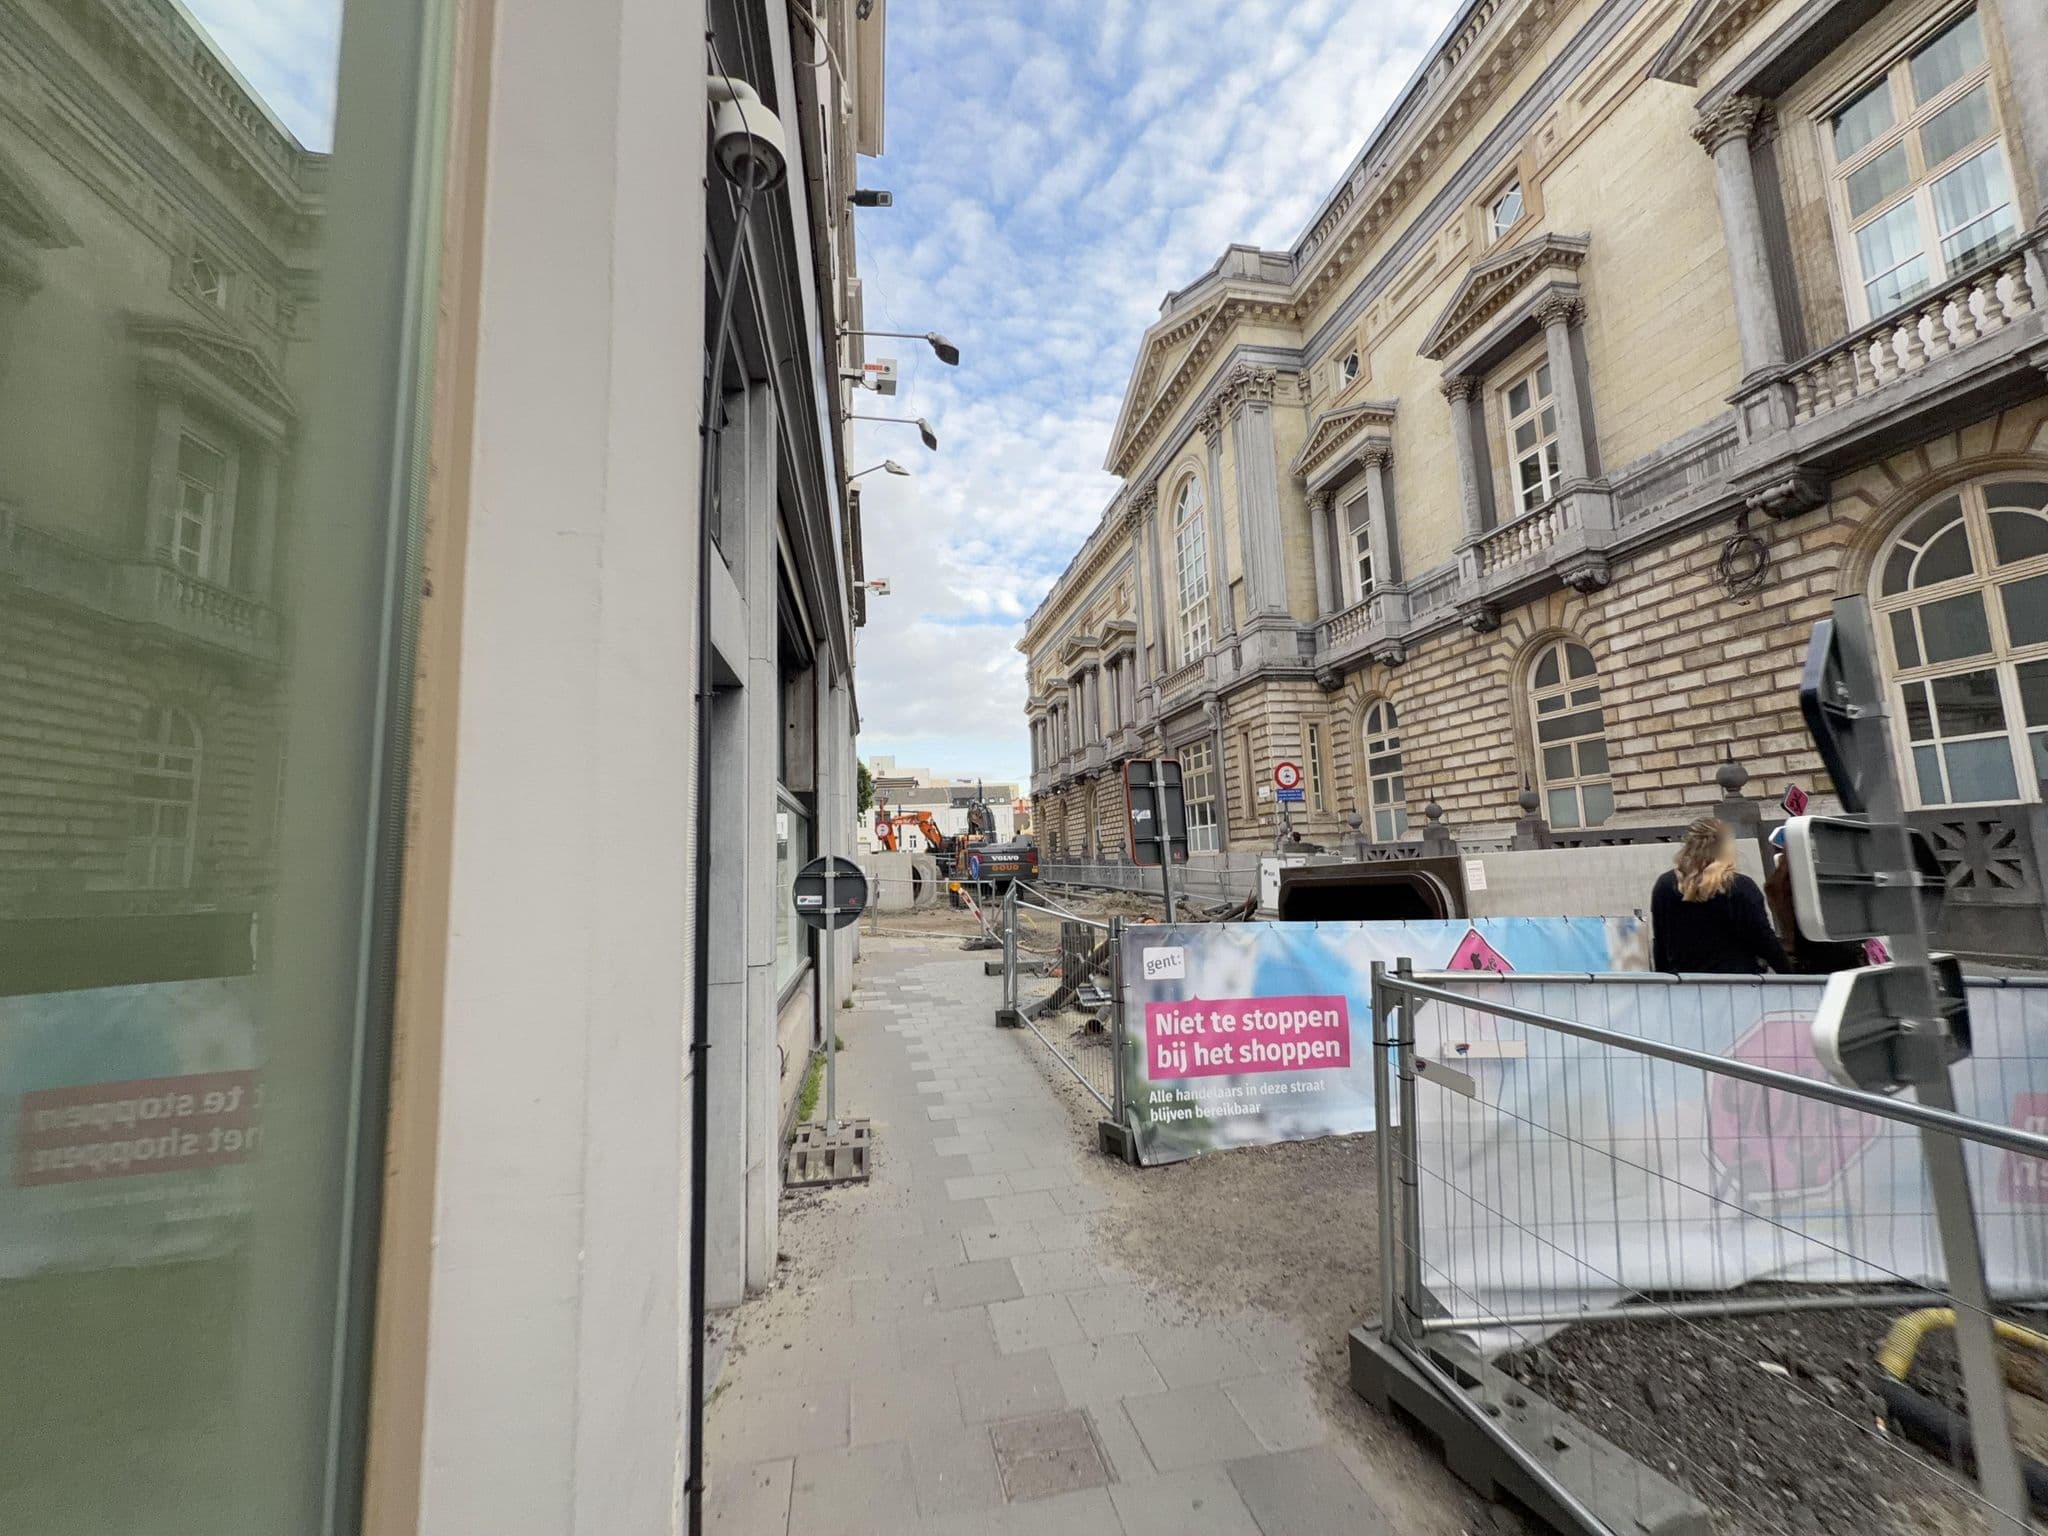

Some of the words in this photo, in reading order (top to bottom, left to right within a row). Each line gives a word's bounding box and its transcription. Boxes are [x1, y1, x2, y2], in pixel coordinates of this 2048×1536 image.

[1146, 953, 1181, 975] gent:
[1155, 1009, 1206, 1036] Niet
[1210, 1011, 1236, 1033] te
[1242, 1009, 1339, 1035] stoppen
[1157, 1041, 1188, 1073] bij
[1193, 1042, 1234, 1066] het
[1239, 1038, 1341, 1066] shoppen
[1149, 1090, 1173, 1104] Alle
[1175, 1085, 1243, 1102] handelaars
[1245, 1083, 1257, 1097] in
[1259, 1082, 1288, 1096] deze
[1290, 1079, 1326, 1092] straat
[1150, 1107, 1193, 1124] blijven
[1195, 1102, 1262, 1119] bereikbaar
